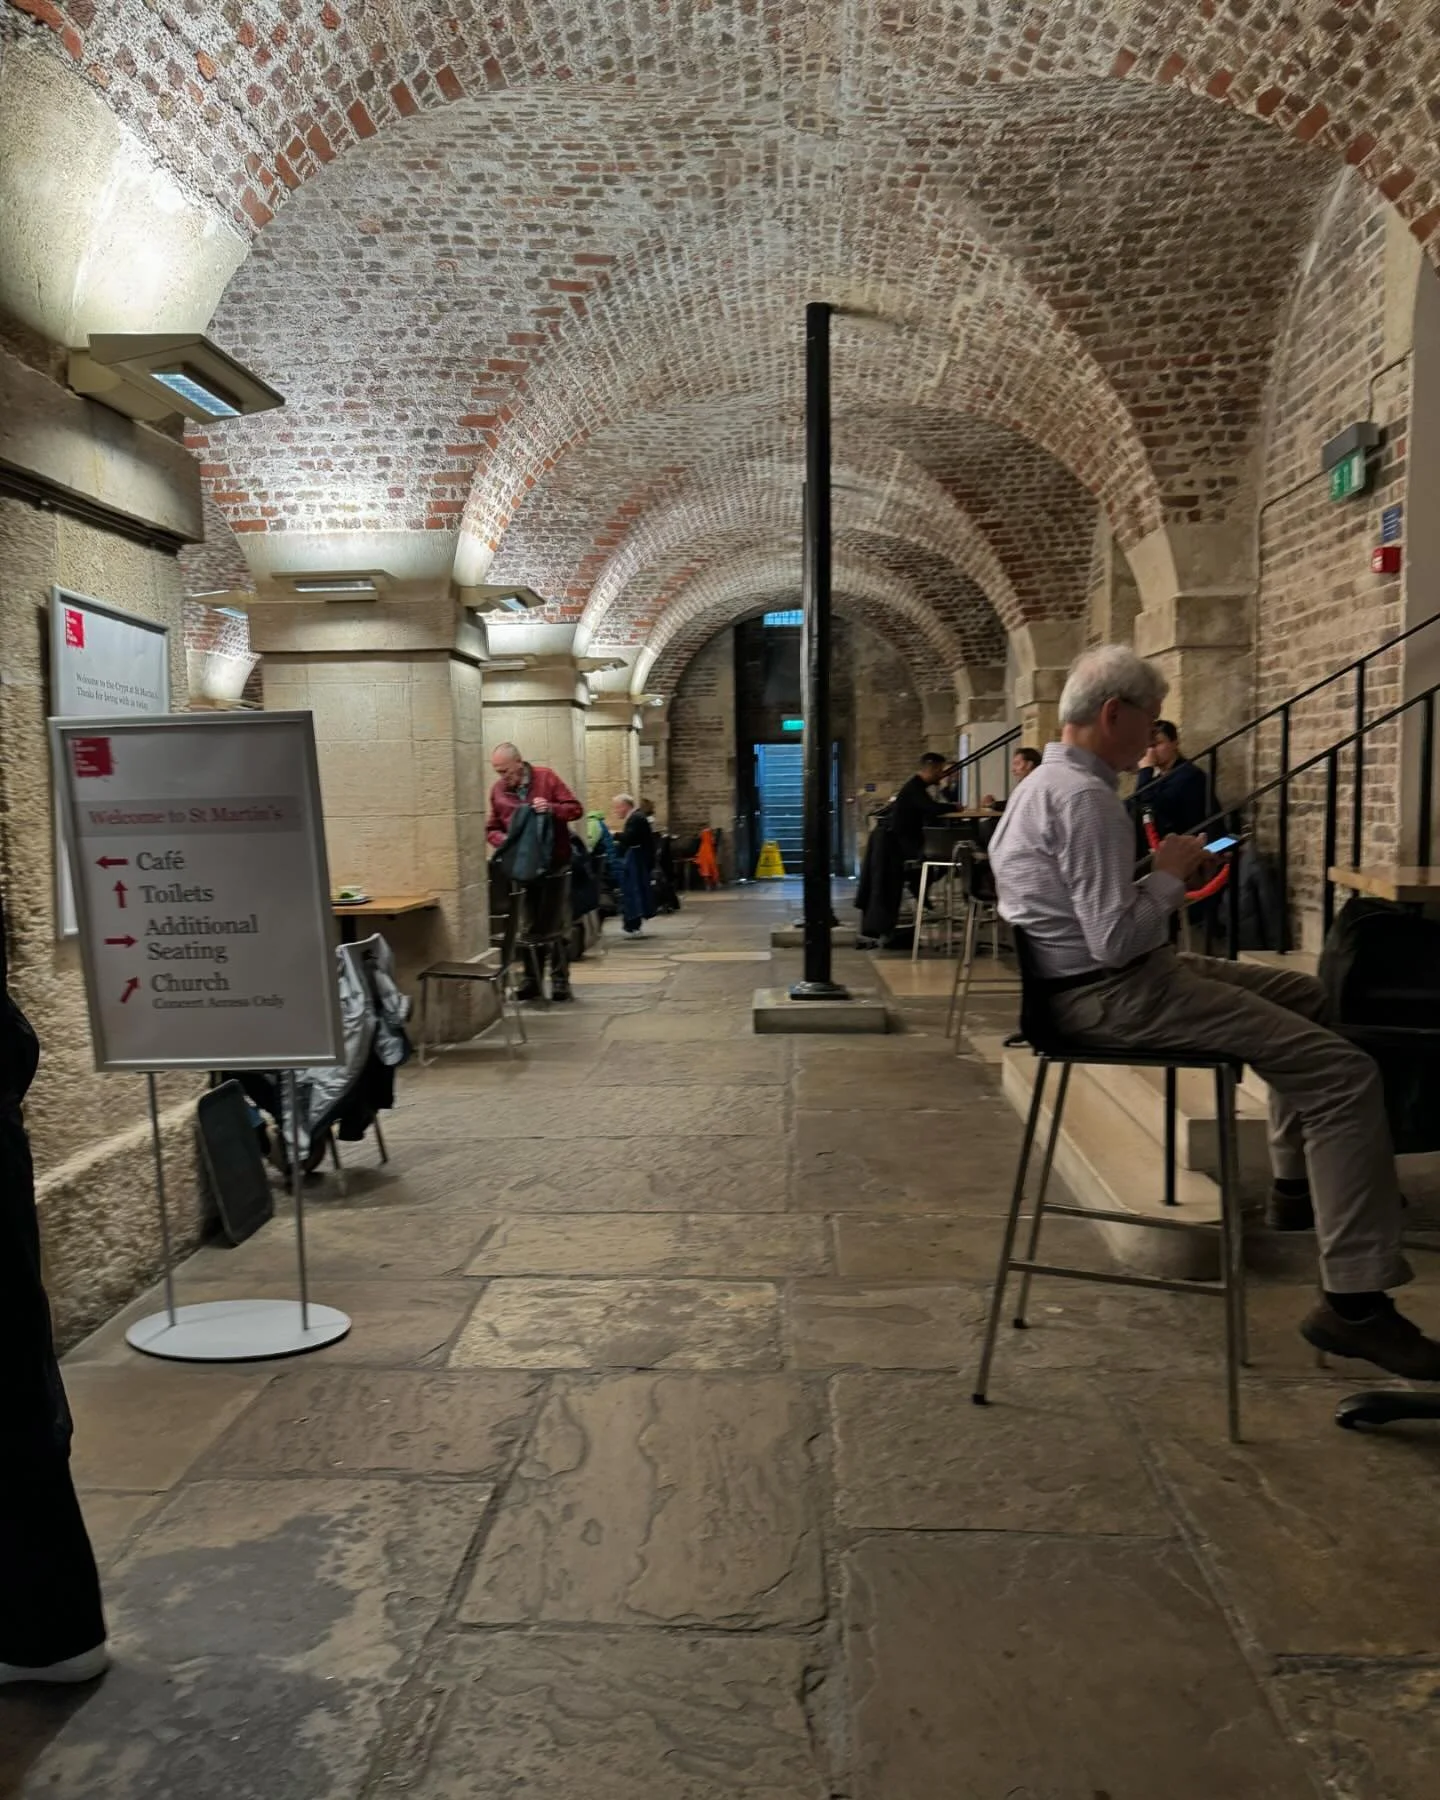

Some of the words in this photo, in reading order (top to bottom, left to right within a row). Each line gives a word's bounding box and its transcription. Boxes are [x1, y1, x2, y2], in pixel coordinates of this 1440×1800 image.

[88, 808, 166, 825] Welcome
[168, 809, 187, 823] to
[189, 807, 208, 823] St
[210, 804, 285, 822] Martin's
[136, 850, 185, 871] Café
[138, 882, 215, 904] Toilets
[144, 914, 259, 936] Additional
[146, 941, 229, 965] Seating
[151, 971, 231, 993] Church
[152, 997, 204, 1009] Concert
[207, 996, 248, 1008] Access
[252, 994, 286, 1010] Only
